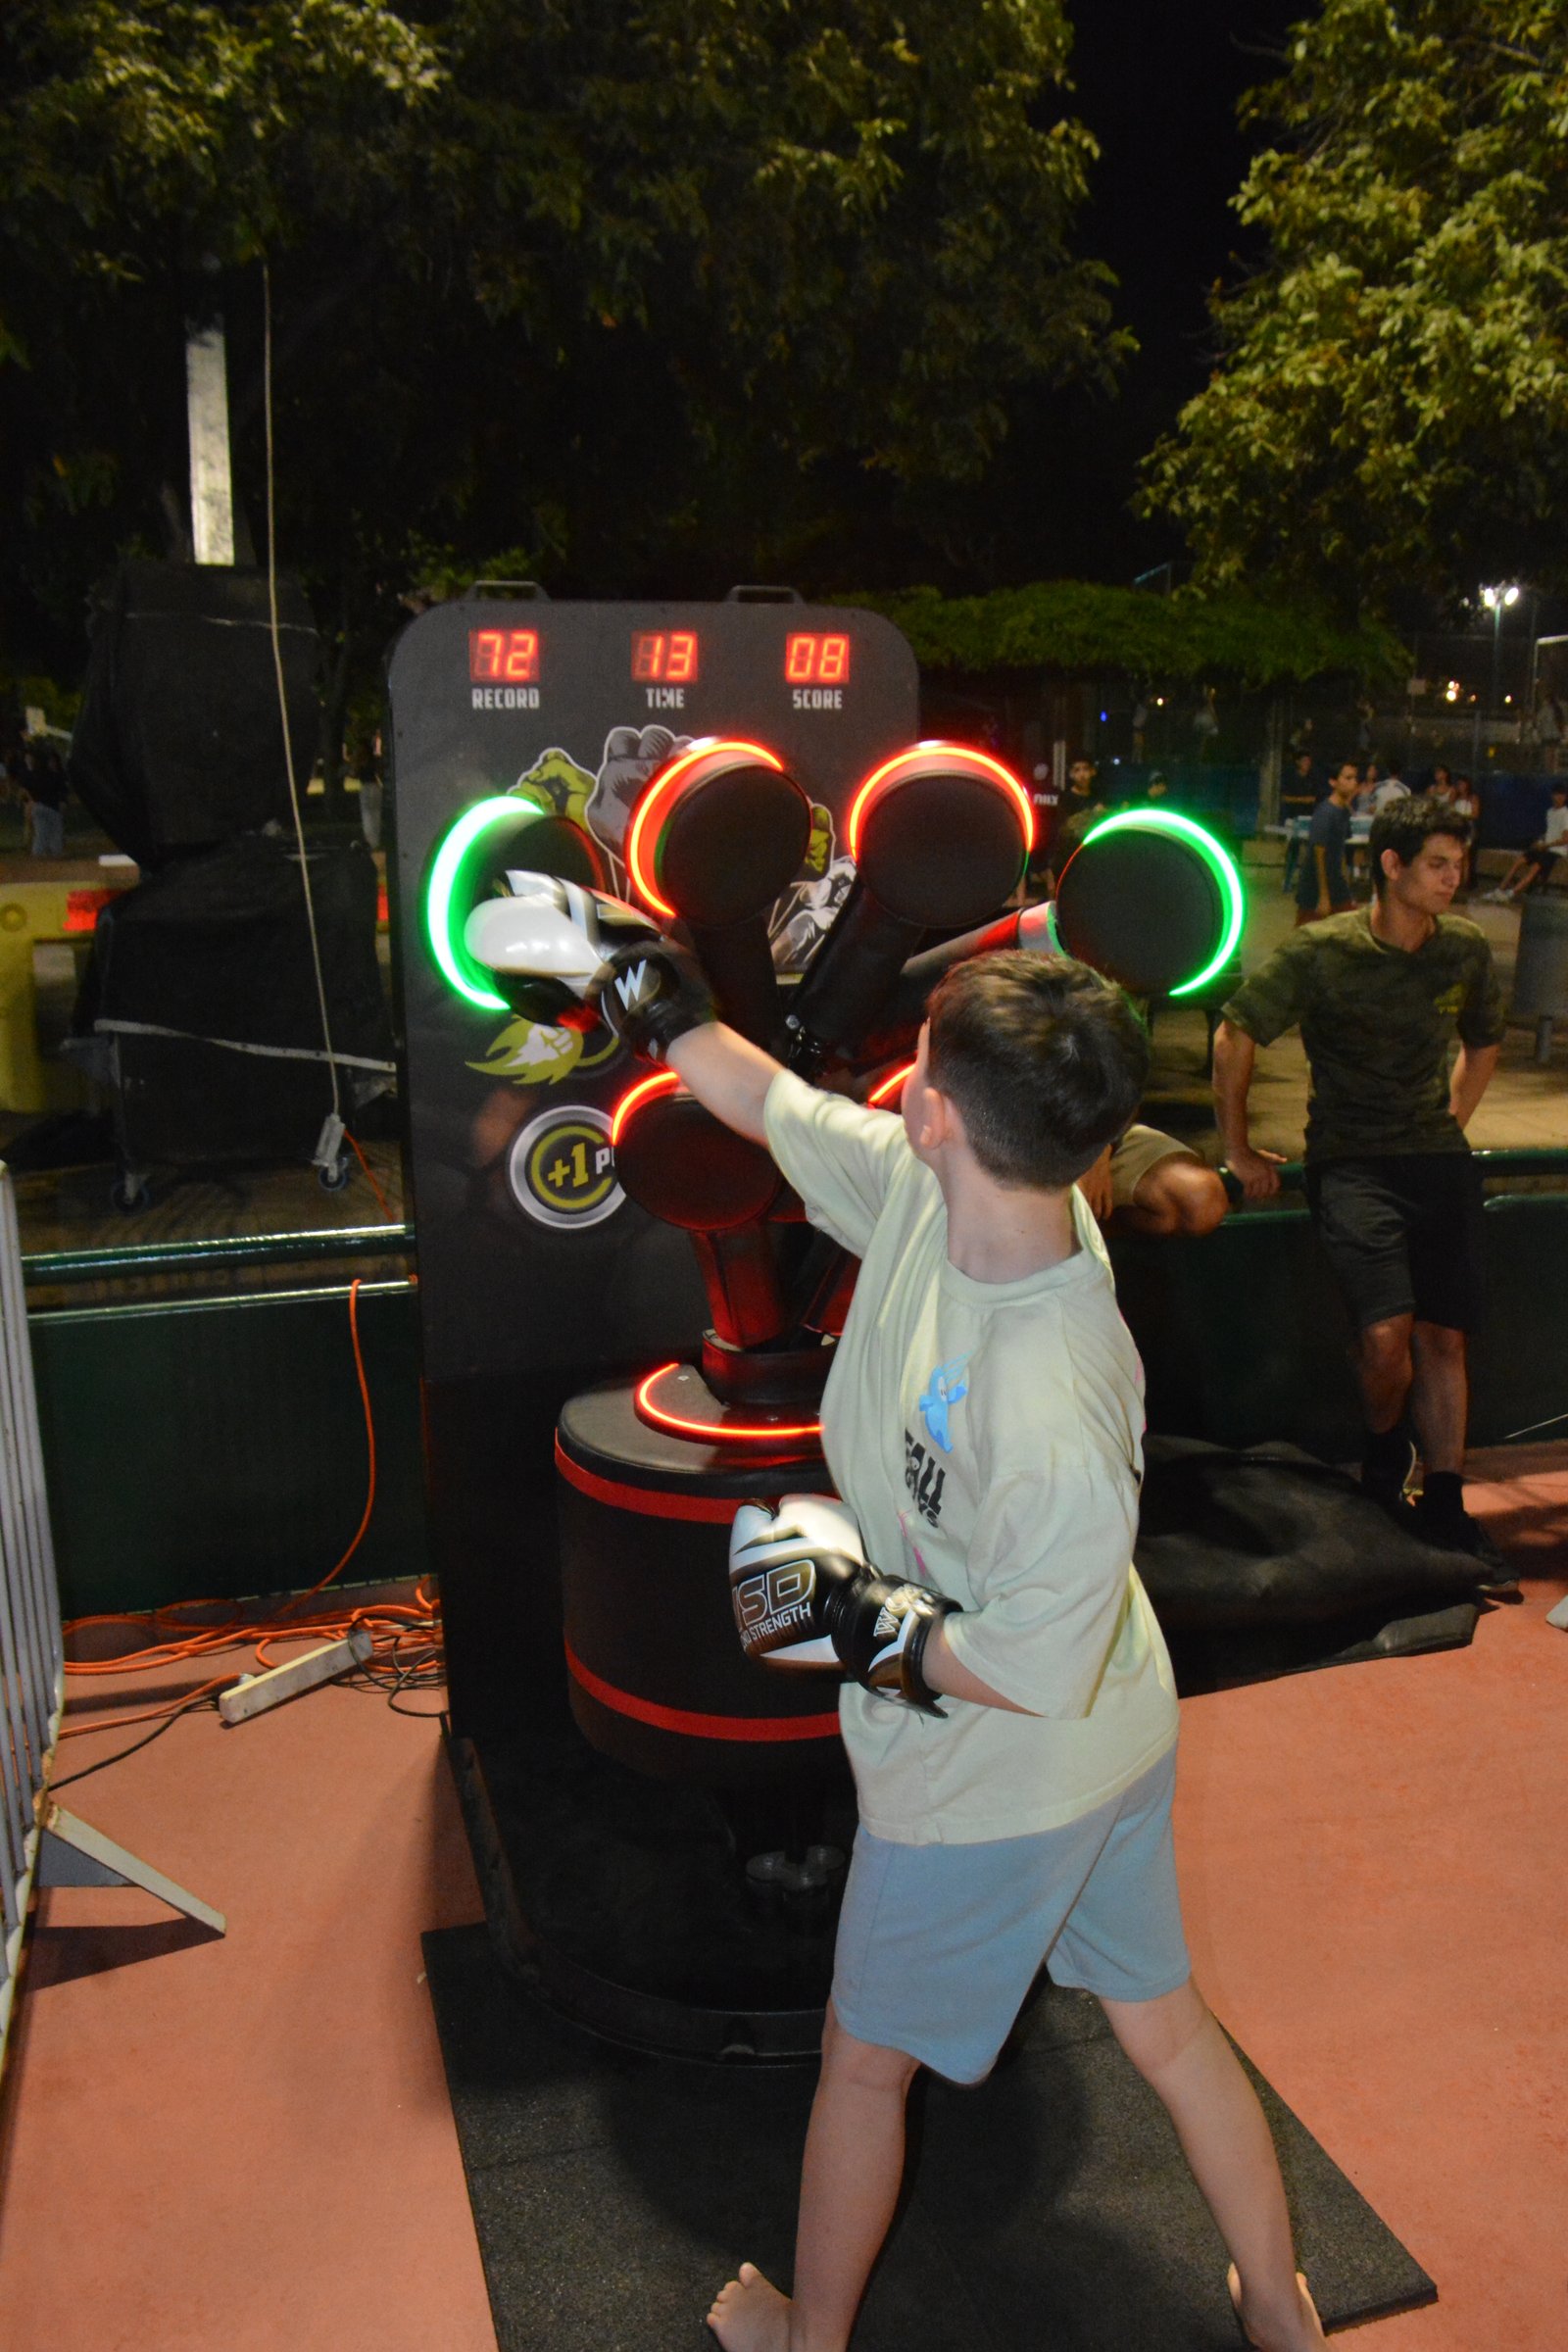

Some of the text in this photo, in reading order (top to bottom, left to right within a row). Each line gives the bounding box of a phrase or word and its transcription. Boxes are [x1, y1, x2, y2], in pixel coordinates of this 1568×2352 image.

[476, 629, 538, 680] 72
[649, 632, 697, 679] 13
[787, 634, 850, 681] 08
[471, 688, 540, 710] RECORD
[646, 688, 685, 710] TIME
[793, 689, 843, 710] SCORE
[548, 1142, 615, 1188] +1 P
[749, 1601, 811, 1642] STRENGTH
